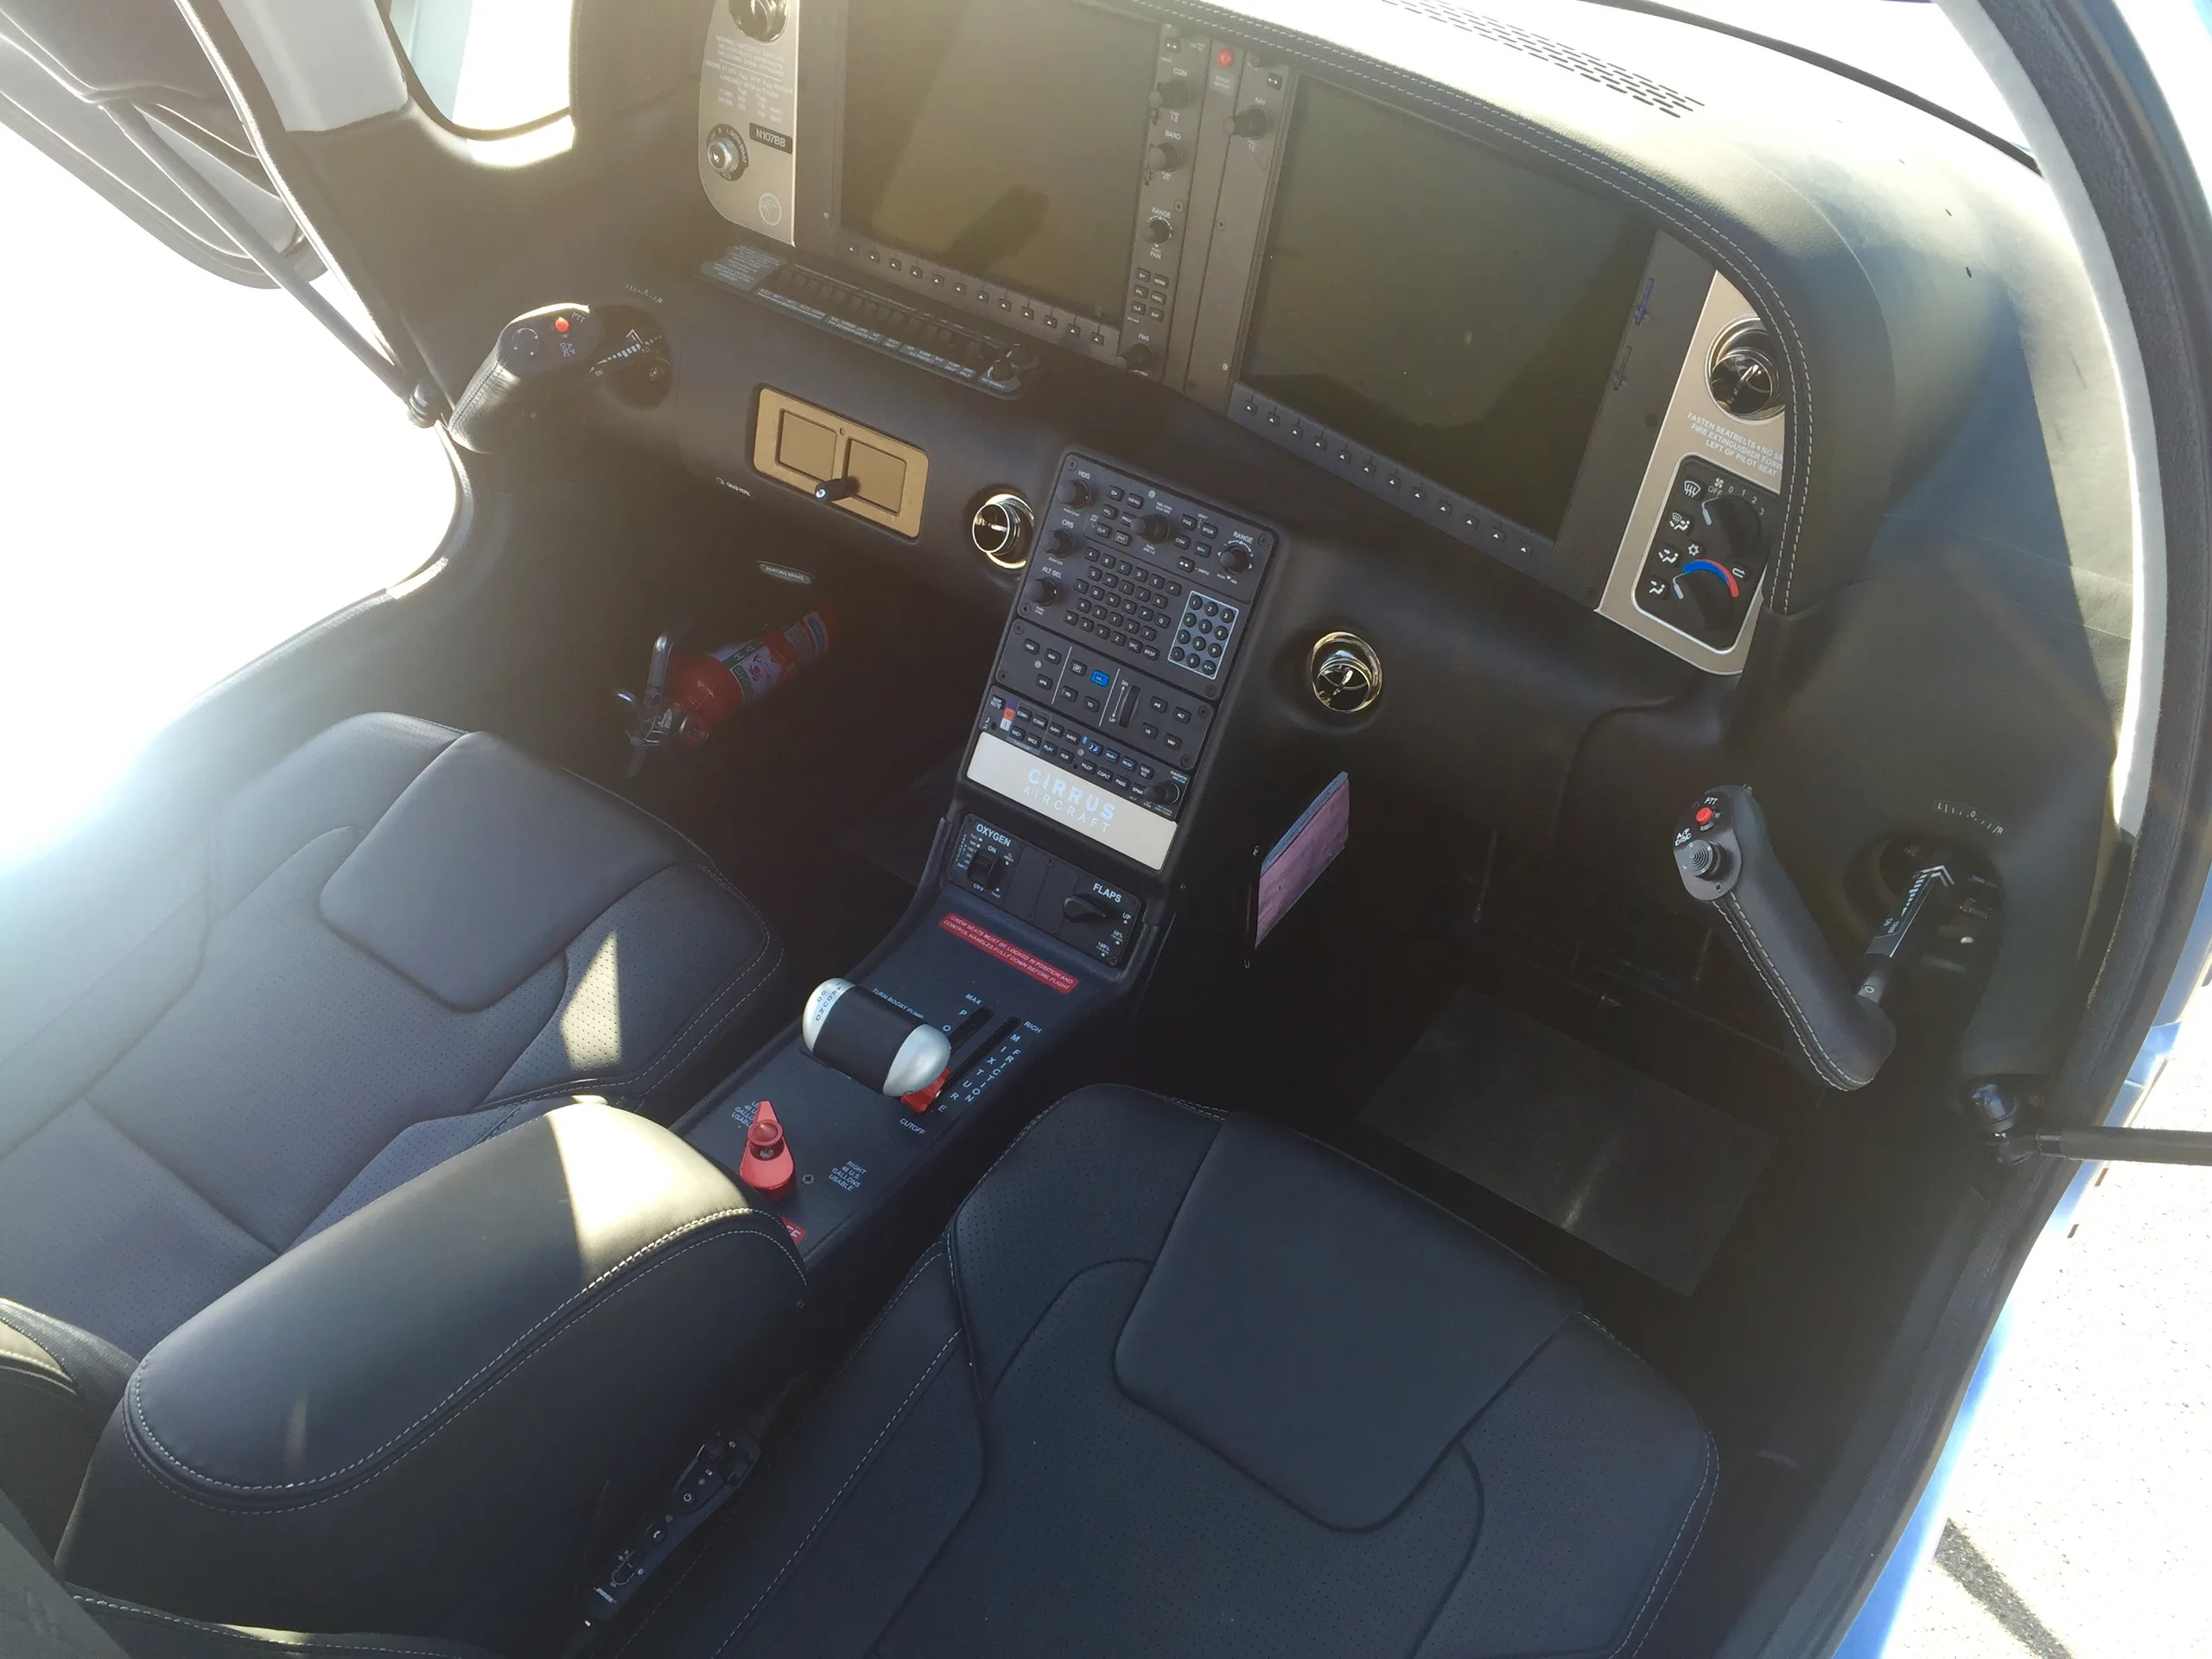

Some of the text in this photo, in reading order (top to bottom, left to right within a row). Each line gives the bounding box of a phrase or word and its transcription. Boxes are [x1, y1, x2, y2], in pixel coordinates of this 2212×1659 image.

[755, 127, 785, 148] N107BB
[1152, 207, 1171, 219] RANGE
[1150, 250, 1161, 259] PAN
[1687, 412, 1714, 430] FASTEN
[1716, 424, 1757, 449] SEATBELTS
[1761, 446, 1773, 457] NO
[1691, 423, 1707, 435] FIRE
[1708, 430, 1760, 461] EXTINGUISHER
[1706, 439, 1725, 453] LEFT
[1725, 447, 1736, 457] OF
[1736, 453, 1758, 468] PILOT
[1758, 463, 1777, 477] SEAT
[1077, 471, 1090, 480] HDG
[1707, 485, 1723, 497] OFF
[1758, 507, 1764, 516] 3
[1062, 519, 1074, 529] CRS
[1232, 531, 1253, 544] RANGE
[1052, 569, 1062, 579] SEL
[1027, 768, 1116, 820] CIRRUS
[1704, 797, 1719, 805] PTT
[1022, 785, 1110, 833] AIRCRAFT
[976, 823, 1012, 848] OXYGEN
[988, 845, 998, 854] ON
[1093, 882, 1122, 904] FLAPS
[944, 919, 1070, 990] CONTROL HANDLES FULLY DOWN BEFORE FLIGHT
[950, 916, 967, 930] CREW
[966, 924, 984, 937] SEATS
[983, 933, 1001, 945] MUST
[998, 940, 1008, 949] BE
[1006, 946, 1030, 962] LOCKED
[1034, 960, 1062, 977] POSITION
[1059, 973, 1075, 984] AND
[873, 988, 888, 1001] TURN
[887, 996, 908, 1010] BOOST
[965, 994, 982, 1006] MAX
[1024, 1020, 1042, 1033] RICH
[938, 1033, 1020, 1112] MIXTURE
[964, 1049, 1020, 1103] FRICTION
[899, 1118, 925, 1135] CUTOFF
[847, 1160, 867, 1174] RIGHT
[829, 1173, 855, 1192] USABLE
[831, 1167, 861, 1187] GALLONS
